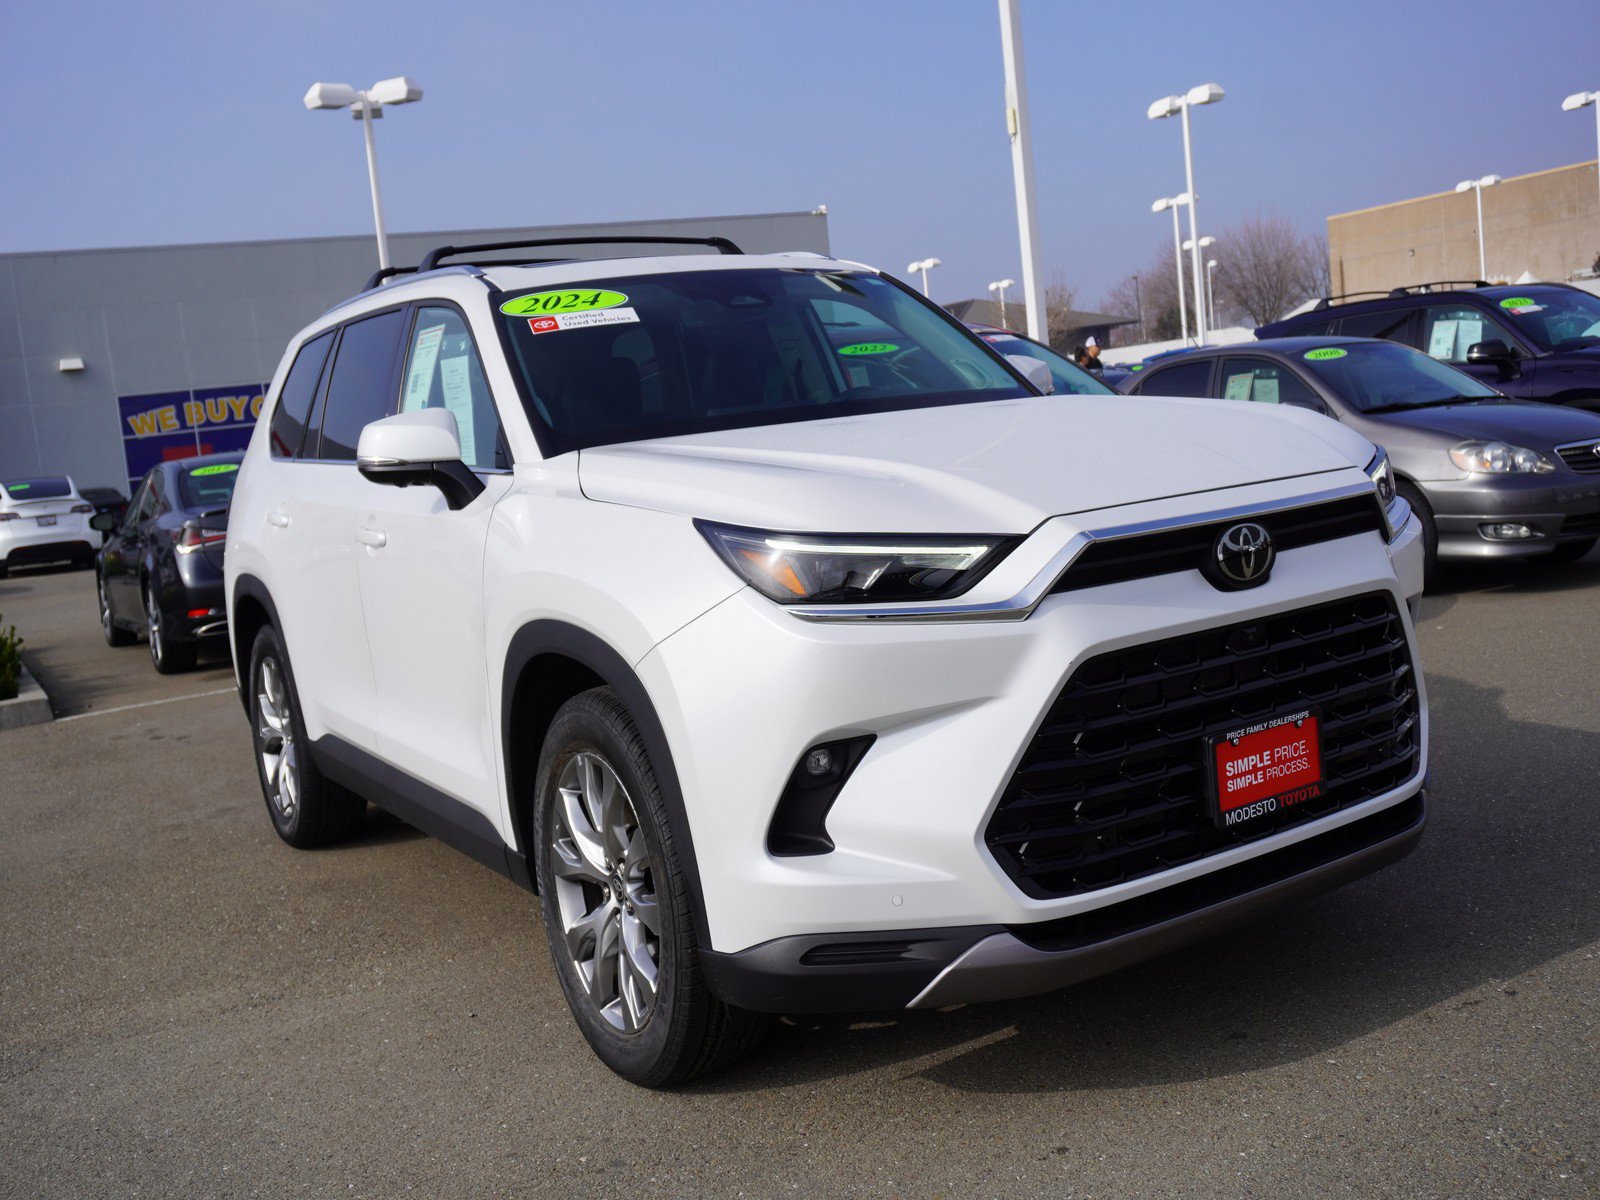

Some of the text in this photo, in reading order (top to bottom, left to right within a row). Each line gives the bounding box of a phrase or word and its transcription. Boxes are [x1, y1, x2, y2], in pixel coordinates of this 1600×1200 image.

[520, 292, 602, 313] 2024
[561, 312, 604, 321] Certified
[564, 316, 632, 327] Used Vehicles
[850, 344, 887, 353] 2022
[127, 405, 180, 438] WE
[183, 396, 250, 427] BUY
[1226, 710, 1309, 740] PRICE FAMILY DEALERSHIPS
[1225, 740, 1309, 777] SIMPLE PRICE.
[1227, 757, 1310, 792] SIMPLE PROCESS.
[1225, 785, 1320, 826] MODESTO TOYOTA
